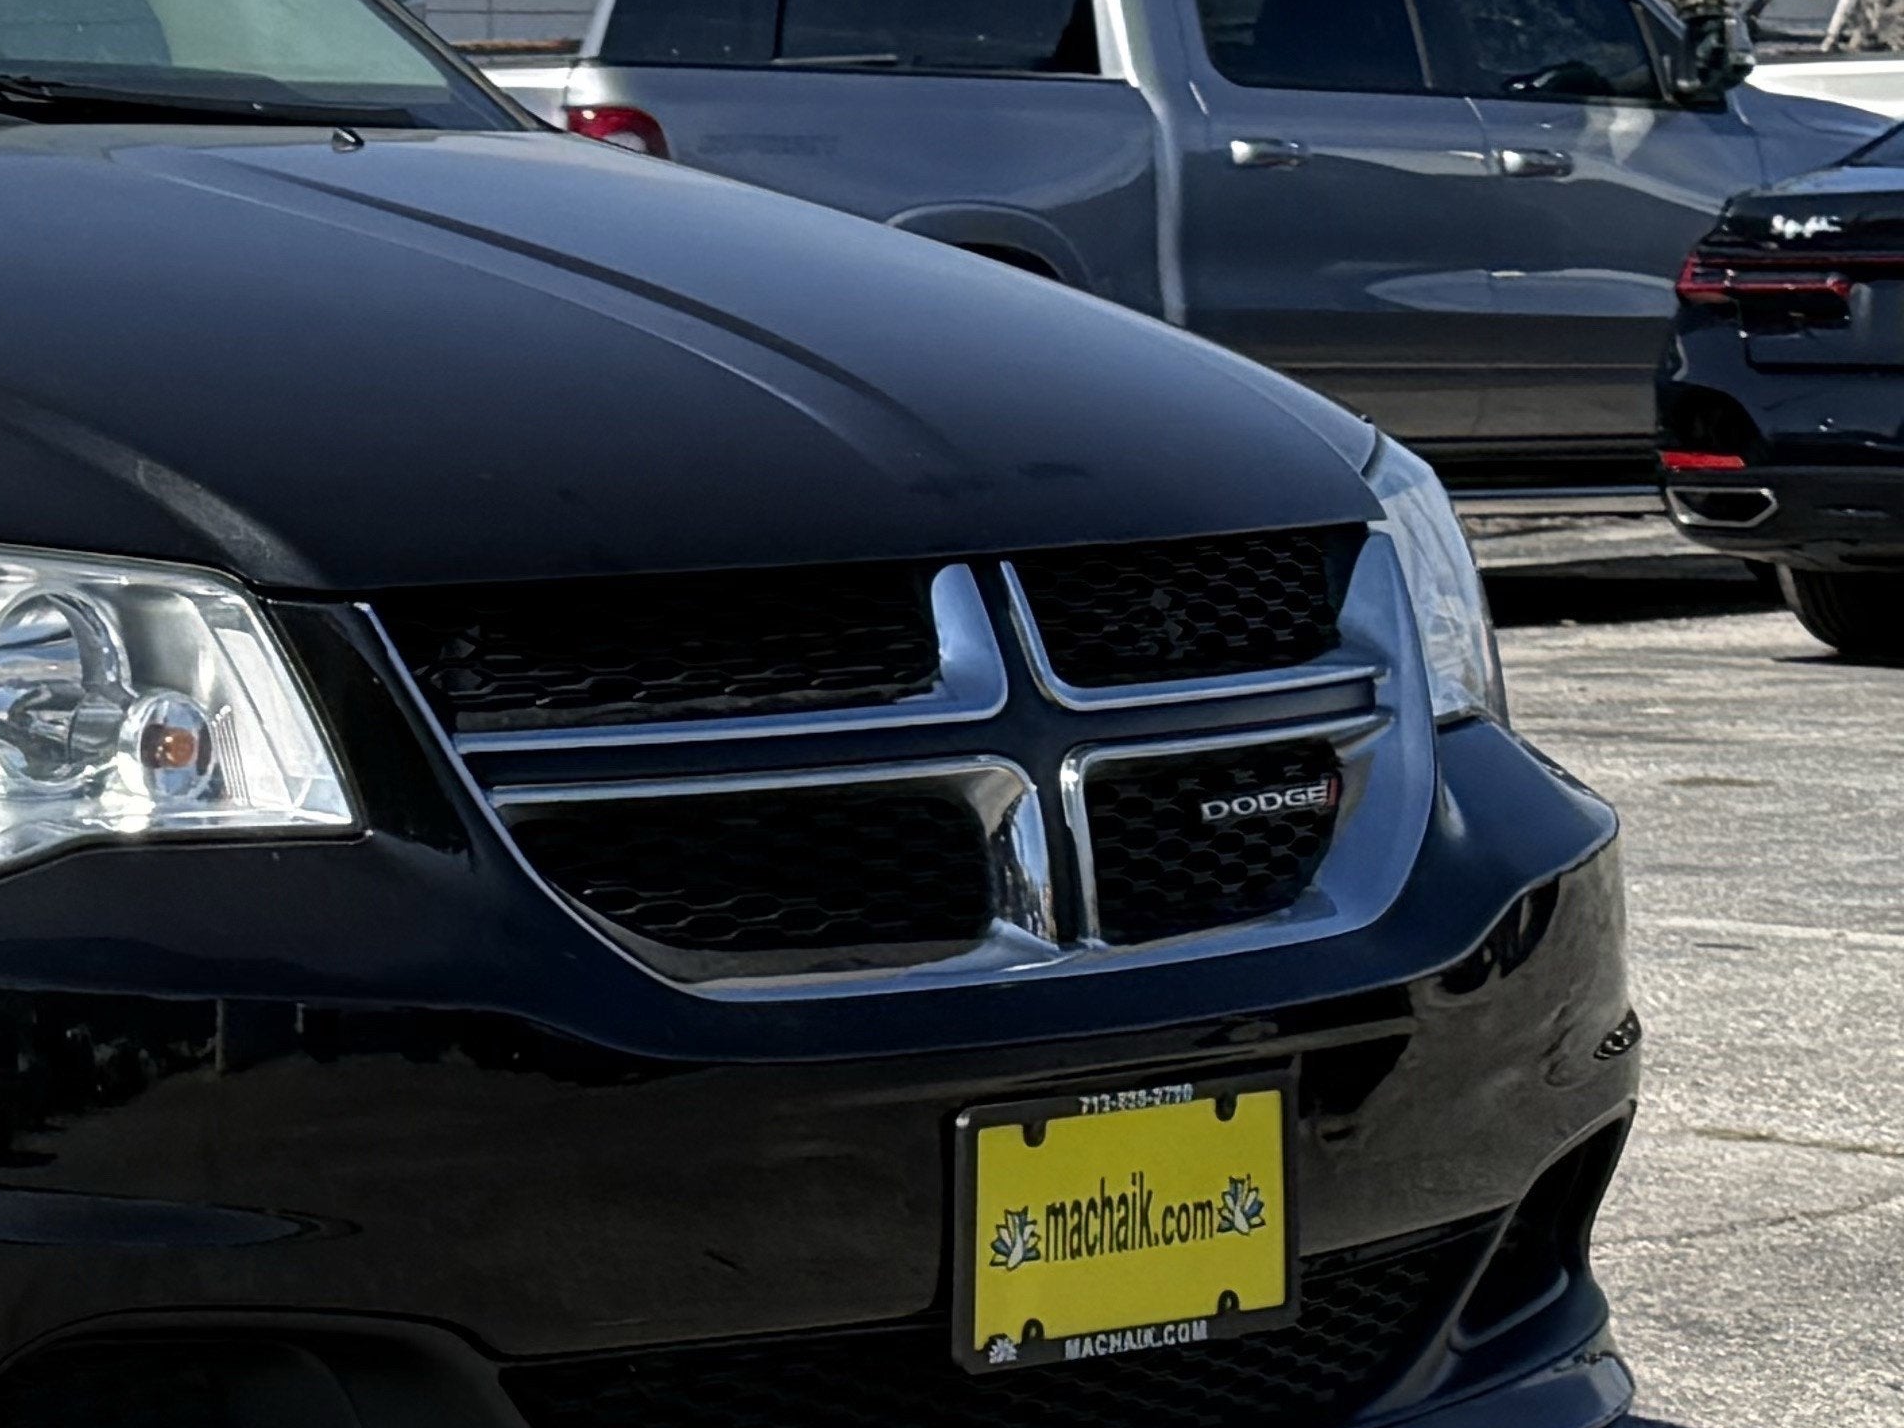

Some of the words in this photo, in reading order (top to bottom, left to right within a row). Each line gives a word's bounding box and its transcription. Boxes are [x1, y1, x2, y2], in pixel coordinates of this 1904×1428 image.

[1200, 779, 1328, 822] DODGE
[1044, 1171, 1214, 1263] machaik.com
[1064, 1320, 1208, 1360] MACHAIK.COM
